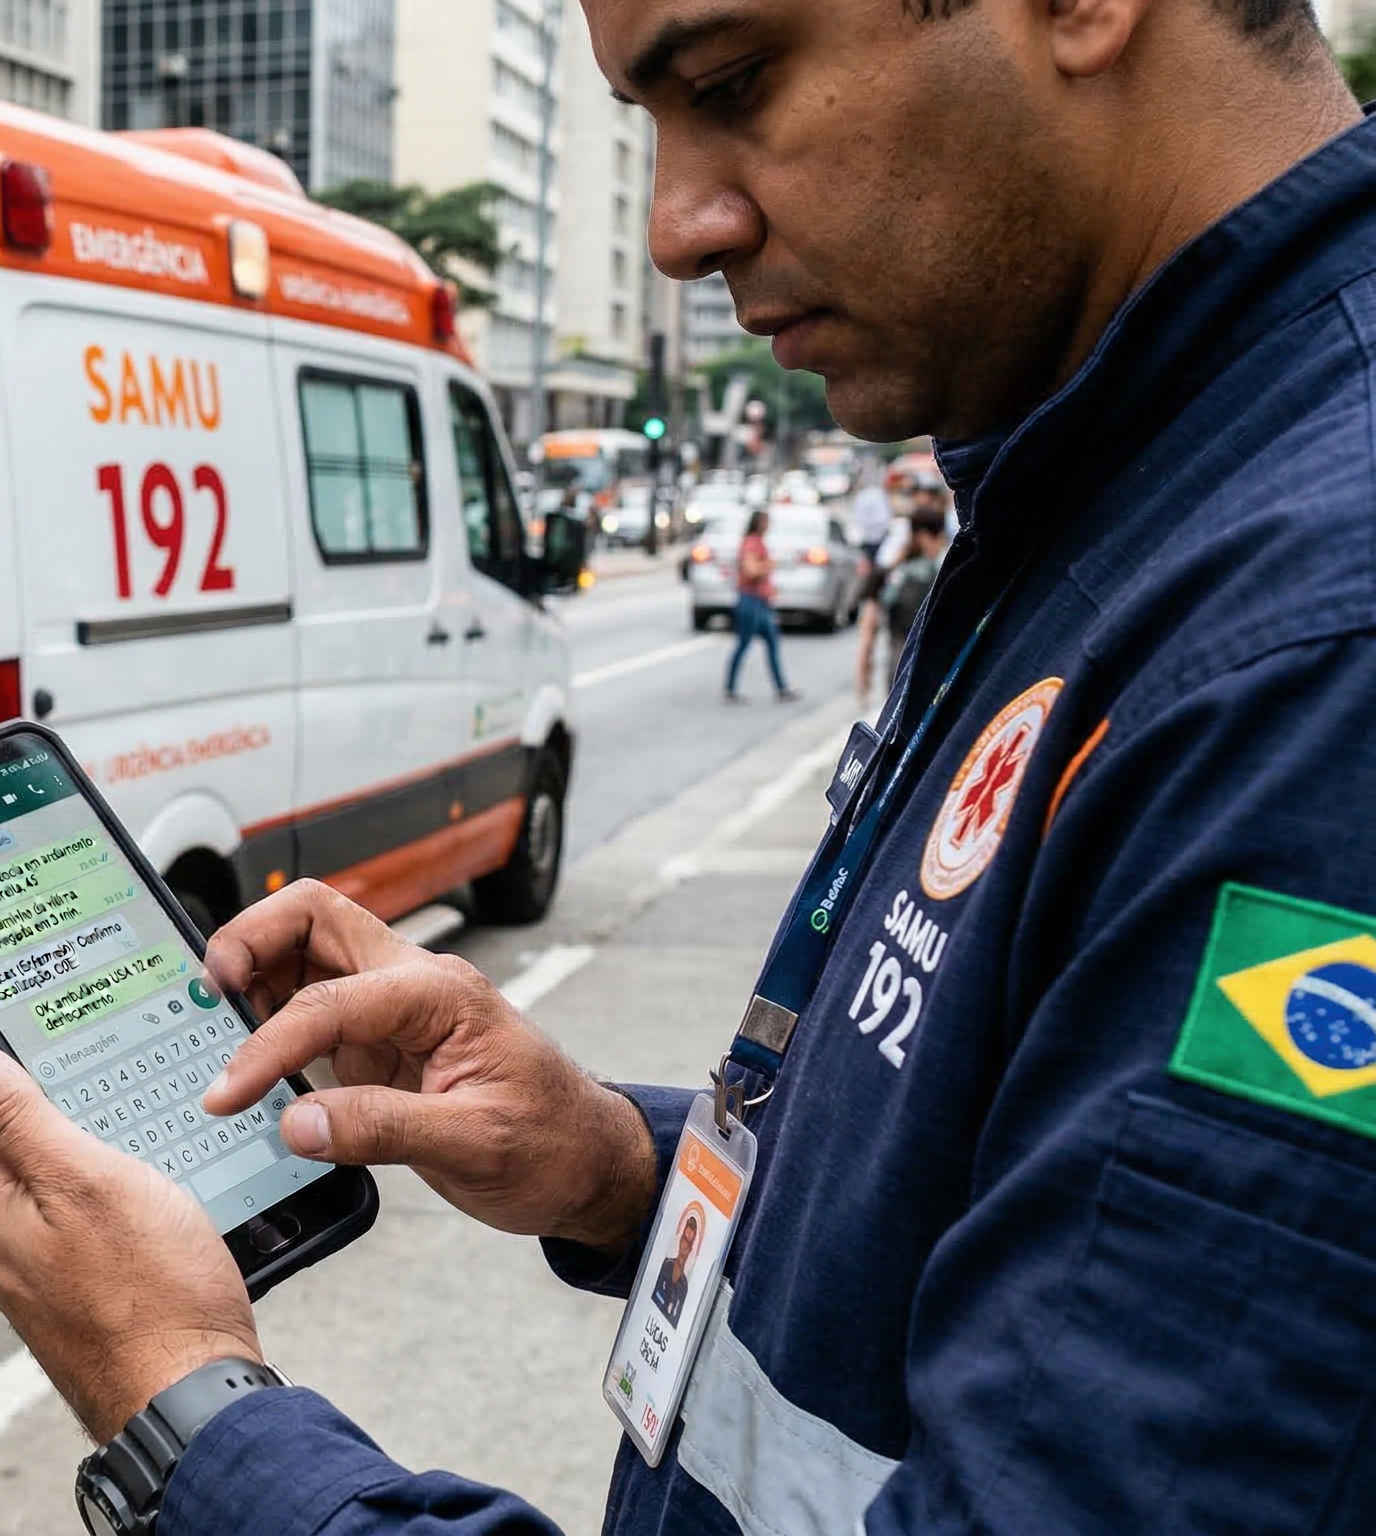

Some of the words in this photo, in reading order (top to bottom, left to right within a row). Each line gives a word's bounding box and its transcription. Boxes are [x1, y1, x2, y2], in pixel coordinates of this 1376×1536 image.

[84, 345, 220, 431] SAMU
[98, 462, 234, 599] 192
[884, 890, 949, 973] SAMU
[848, 940, 923, 1069] 192
[61, 1098, 72, 1110] 1
[80, 1088, 94, 1103] 2
[98, 1079, 110, 1092] 3
[136, 1060, 147, 1073] 5
[154, 1051, 165, 1064] 6
[170, 1043, 181, 1057] 7
[189, 1034, 200, 1047] 8
[206, 1025, 217, 1038] 9
[94, 1116, 110, 1131] W
[114, 1107, 128, 1121] E
[132, 1099, 146, 1111] R
[150, 1089, 161, 1101] T
[168, 1080, 179, 1093] Y
[186, 1071, 198, 1084] U
[128, 1139, 140, 1152] S
[146, 1130, 158, 1143] D
[164, 1120, 174, 1133] F
[183, 1110, 195, 1123] G
[163, 1158, 175, 1173] X
[182, 1150, 193, 1163] C
[198, 1139, 210, 1152] V
[217, 1130, 229, 1143] B
[233, 1119, 248, 1134] N
[250, 1111, 265, 1125] M
